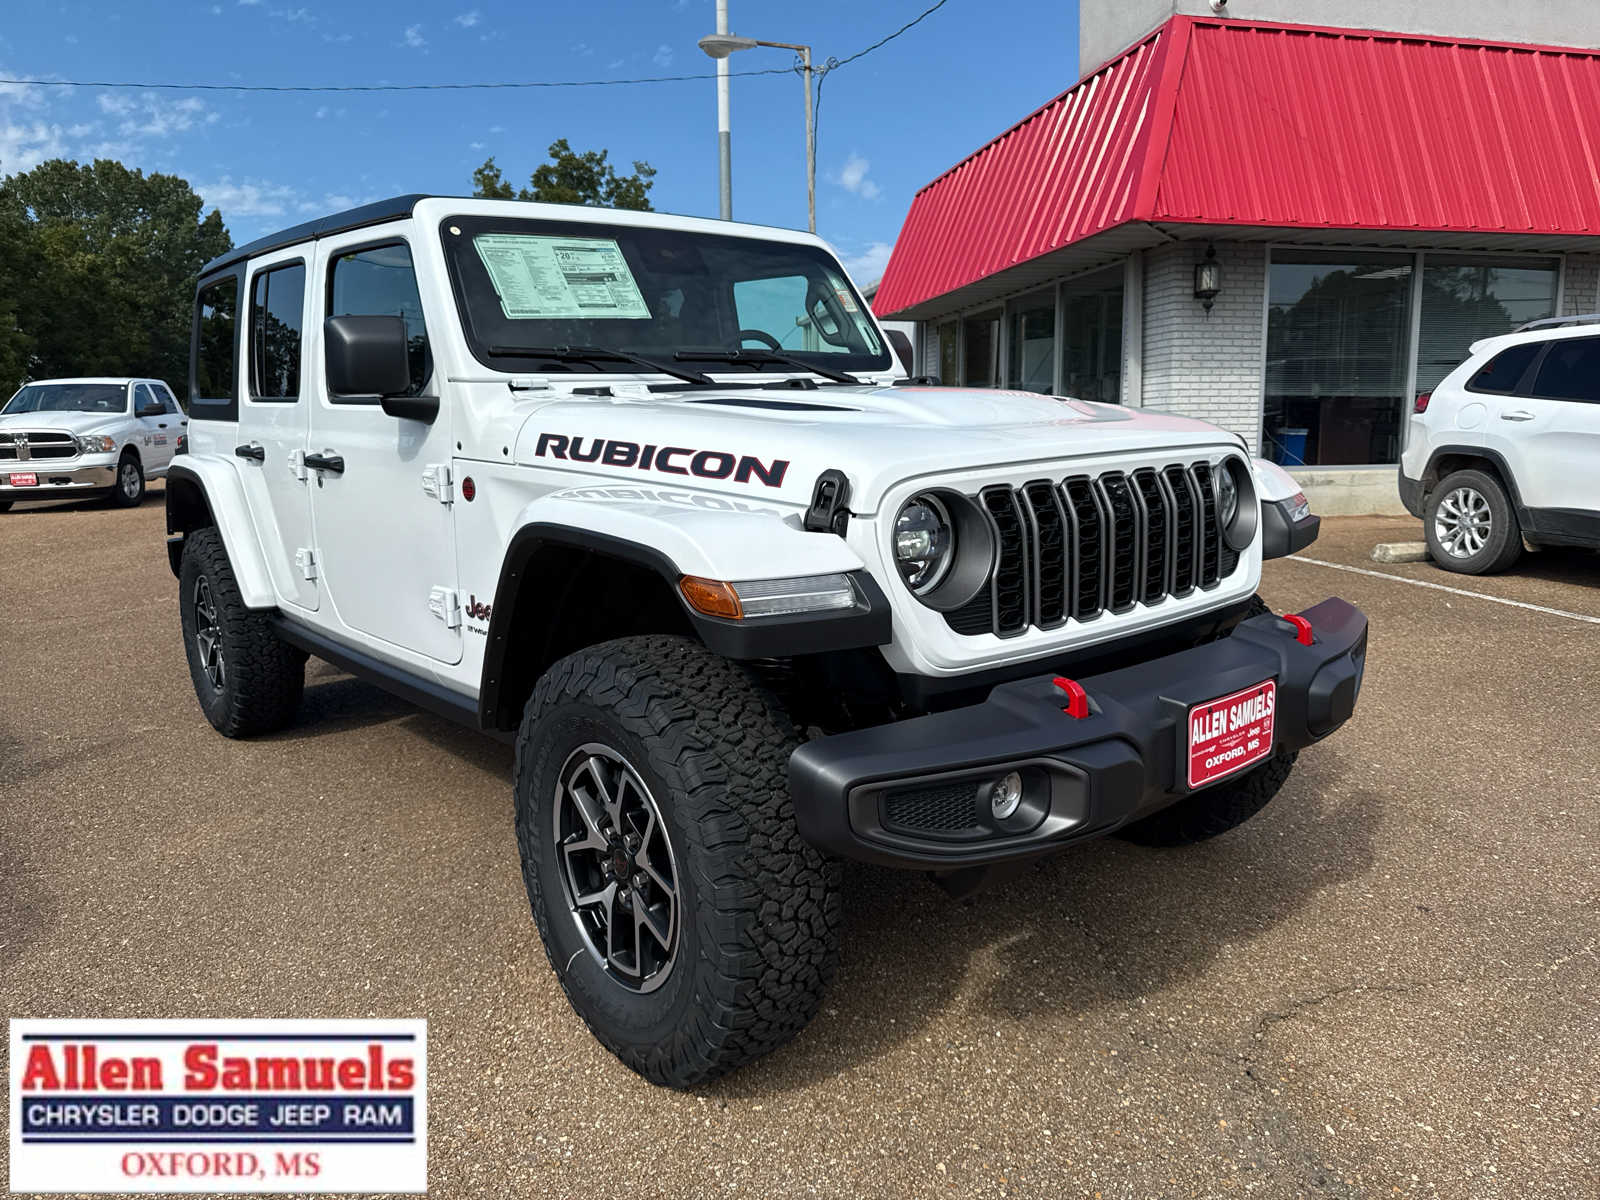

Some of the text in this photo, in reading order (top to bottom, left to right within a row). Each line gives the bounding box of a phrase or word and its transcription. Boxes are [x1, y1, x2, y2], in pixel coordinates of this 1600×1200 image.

[535, 433, 790, 488] RUBICON
[465, 594, 491, 621] Jee
[1192, 690, 1273, 746] ALLEN SAMUELS
[1205, 746, 1247, 769] OXFORD,
[1247, 738, 1260, 751] MS
